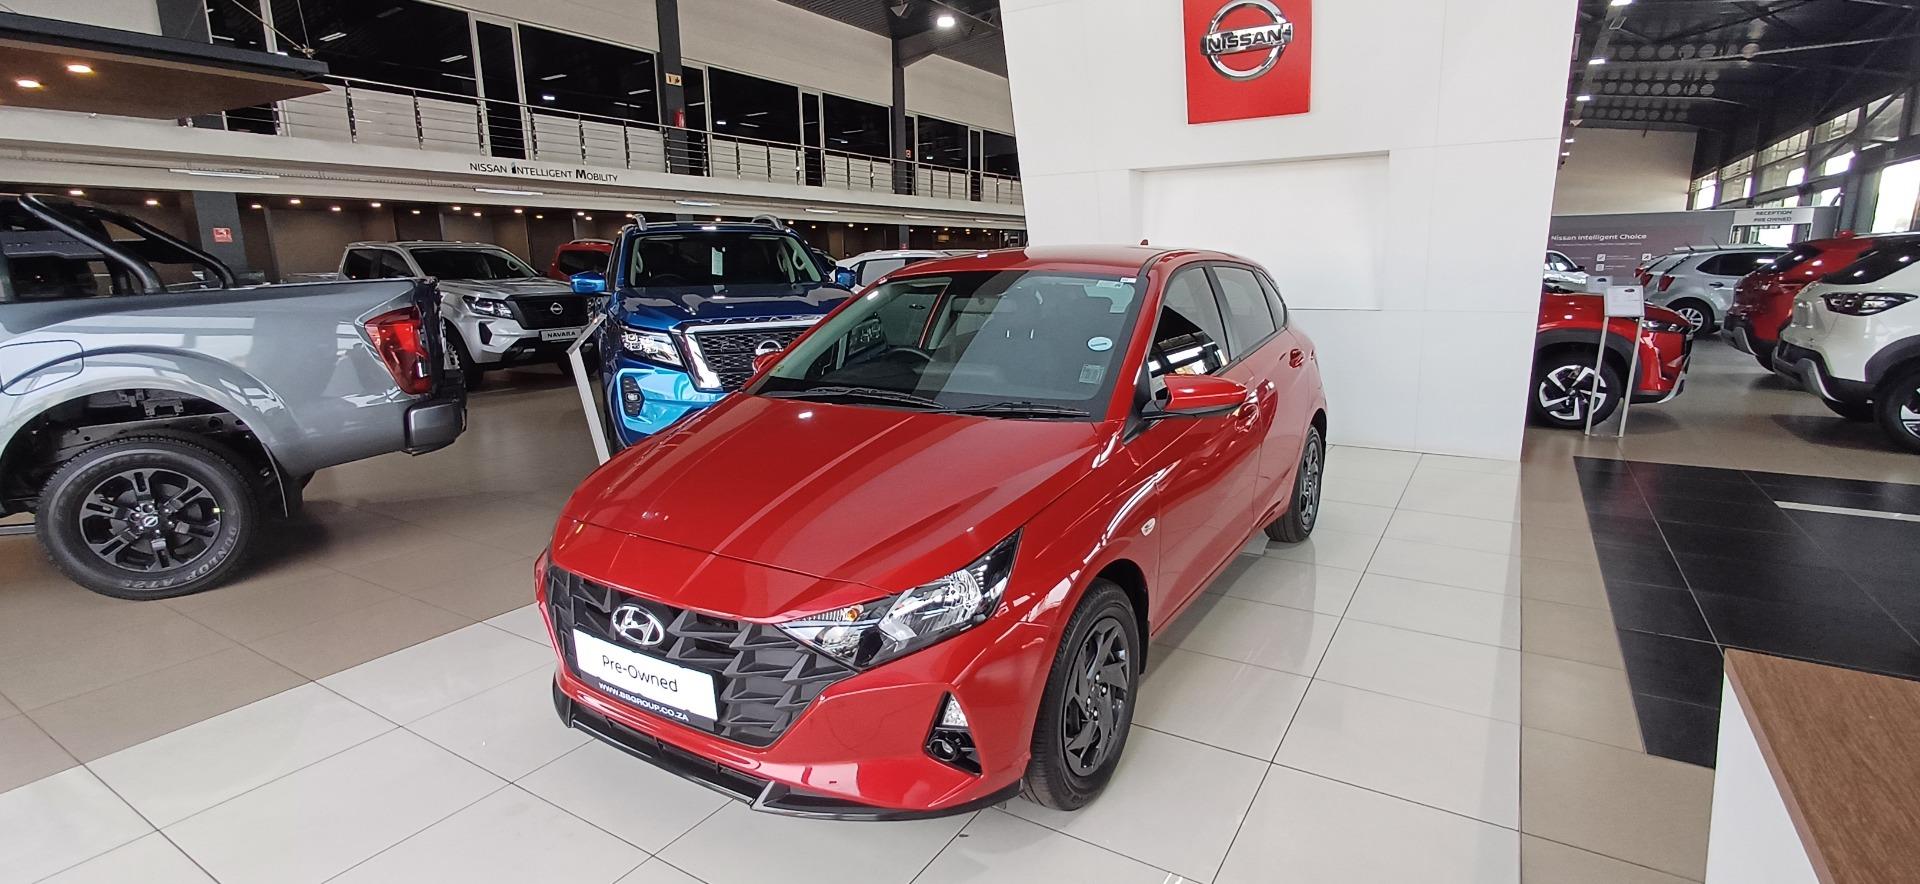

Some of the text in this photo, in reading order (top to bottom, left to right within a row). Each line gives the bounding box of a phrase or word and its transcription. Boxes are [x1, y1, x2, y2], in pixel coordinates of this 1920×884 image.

[1207, 28, 1283, 52] NISSAN
[469, 162, 618, 183] NISSAN INTELLIGENT MOBILITY
[1577, 234, 1618, 242] Intelligent
[602, 655, 678, 693] Pre-Owned
